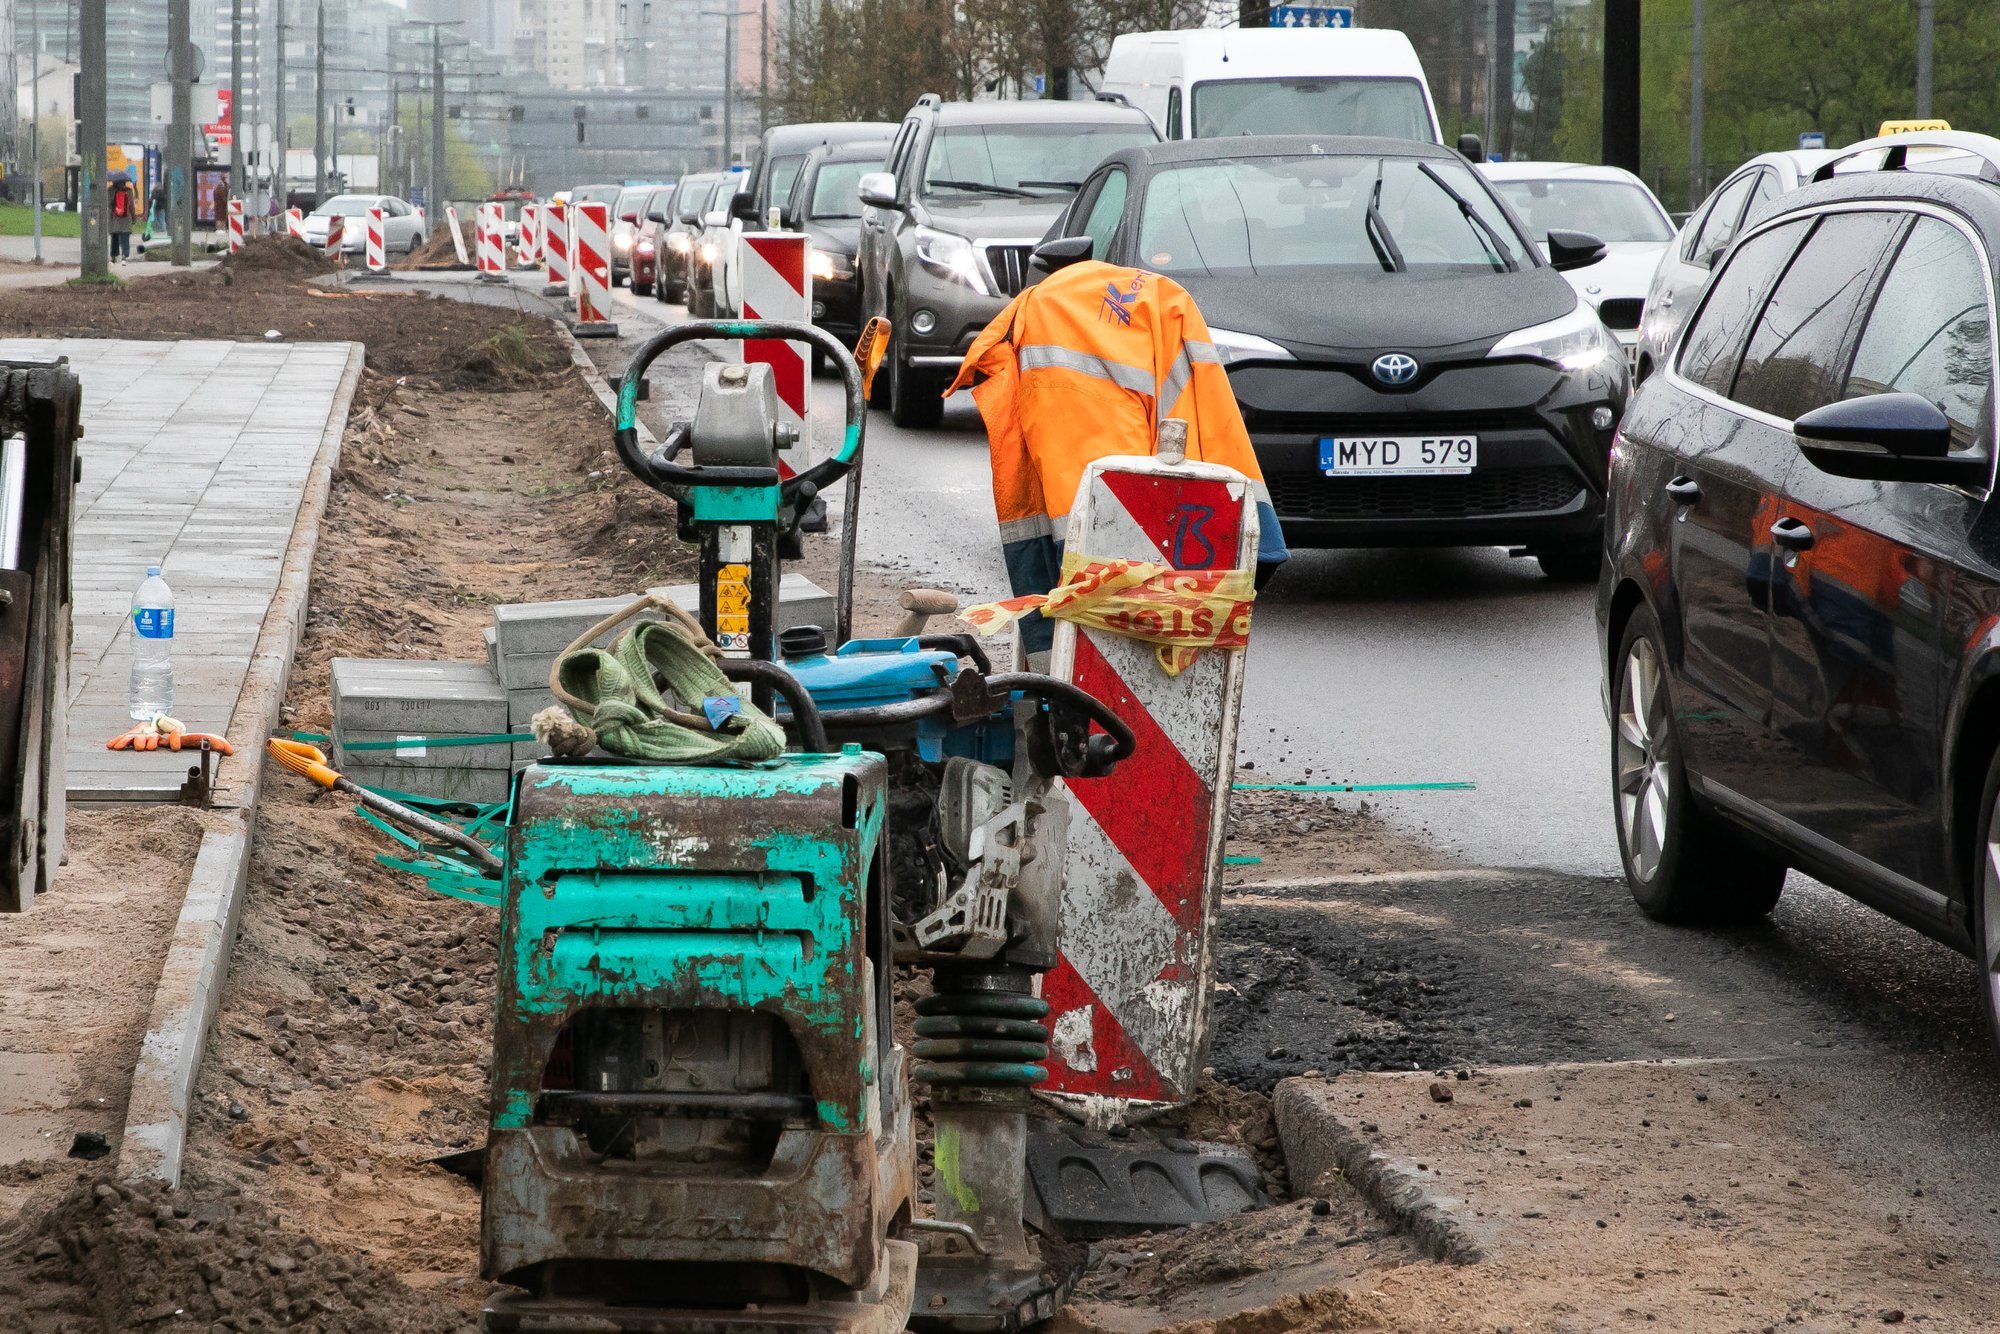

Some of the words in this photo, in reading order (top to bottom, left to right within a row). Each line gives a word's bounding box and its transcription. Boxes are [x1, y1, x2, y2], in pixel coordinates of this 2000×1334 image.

[1321, 457, 1333, 465] LT
[1339, 441, 1400, 466] MYD
[1421, 439, 1472, 464] 579
[1103, 608, 1214, 638] STOP
